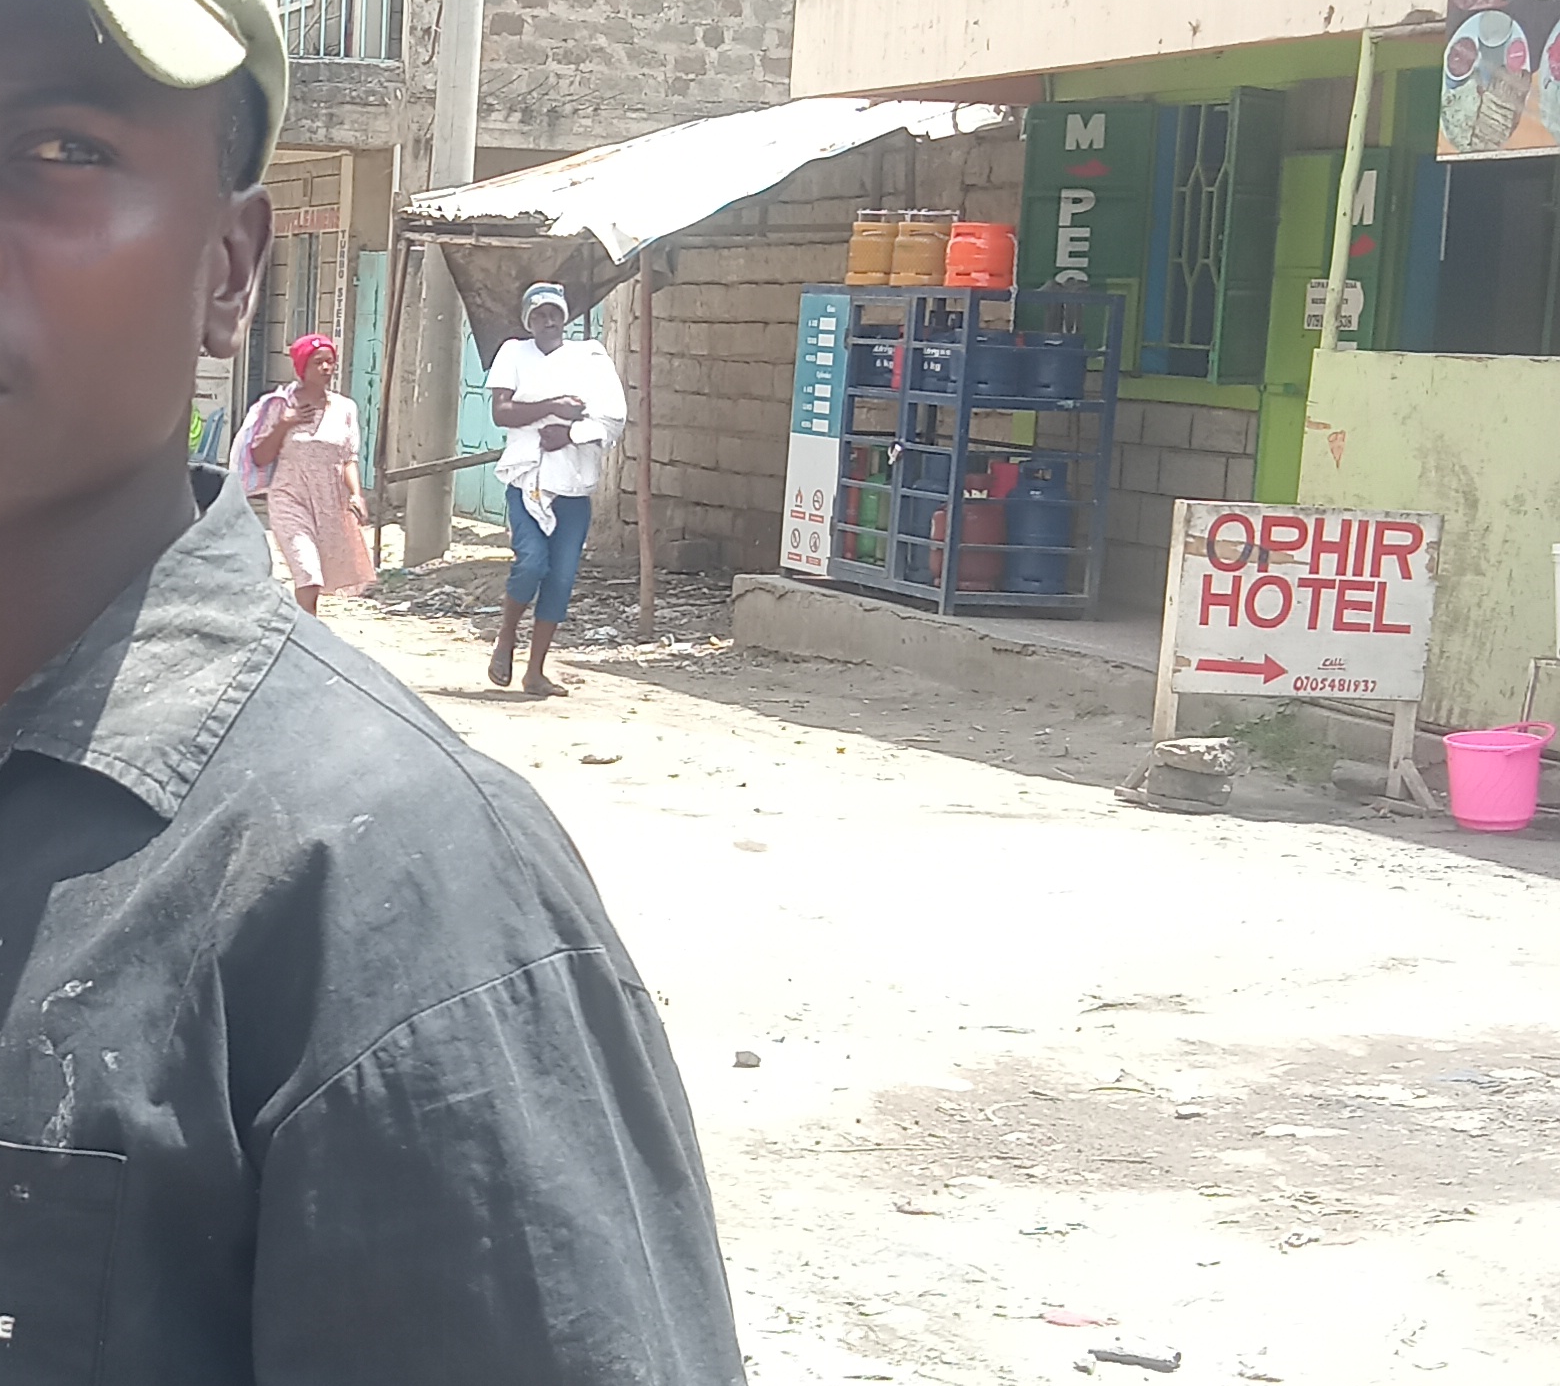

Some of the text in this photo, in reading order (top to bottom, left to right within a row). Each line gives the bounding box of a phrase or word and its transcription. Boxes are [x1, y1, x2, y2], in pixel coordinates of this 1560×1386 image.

[1055, 113, 1106, 284] M PE
[1207, 513, 1424, 580] OPHIR
[1198, 574, 1411, 634] HOTEL
[1293, 676, 1377, 693] 0705481937
